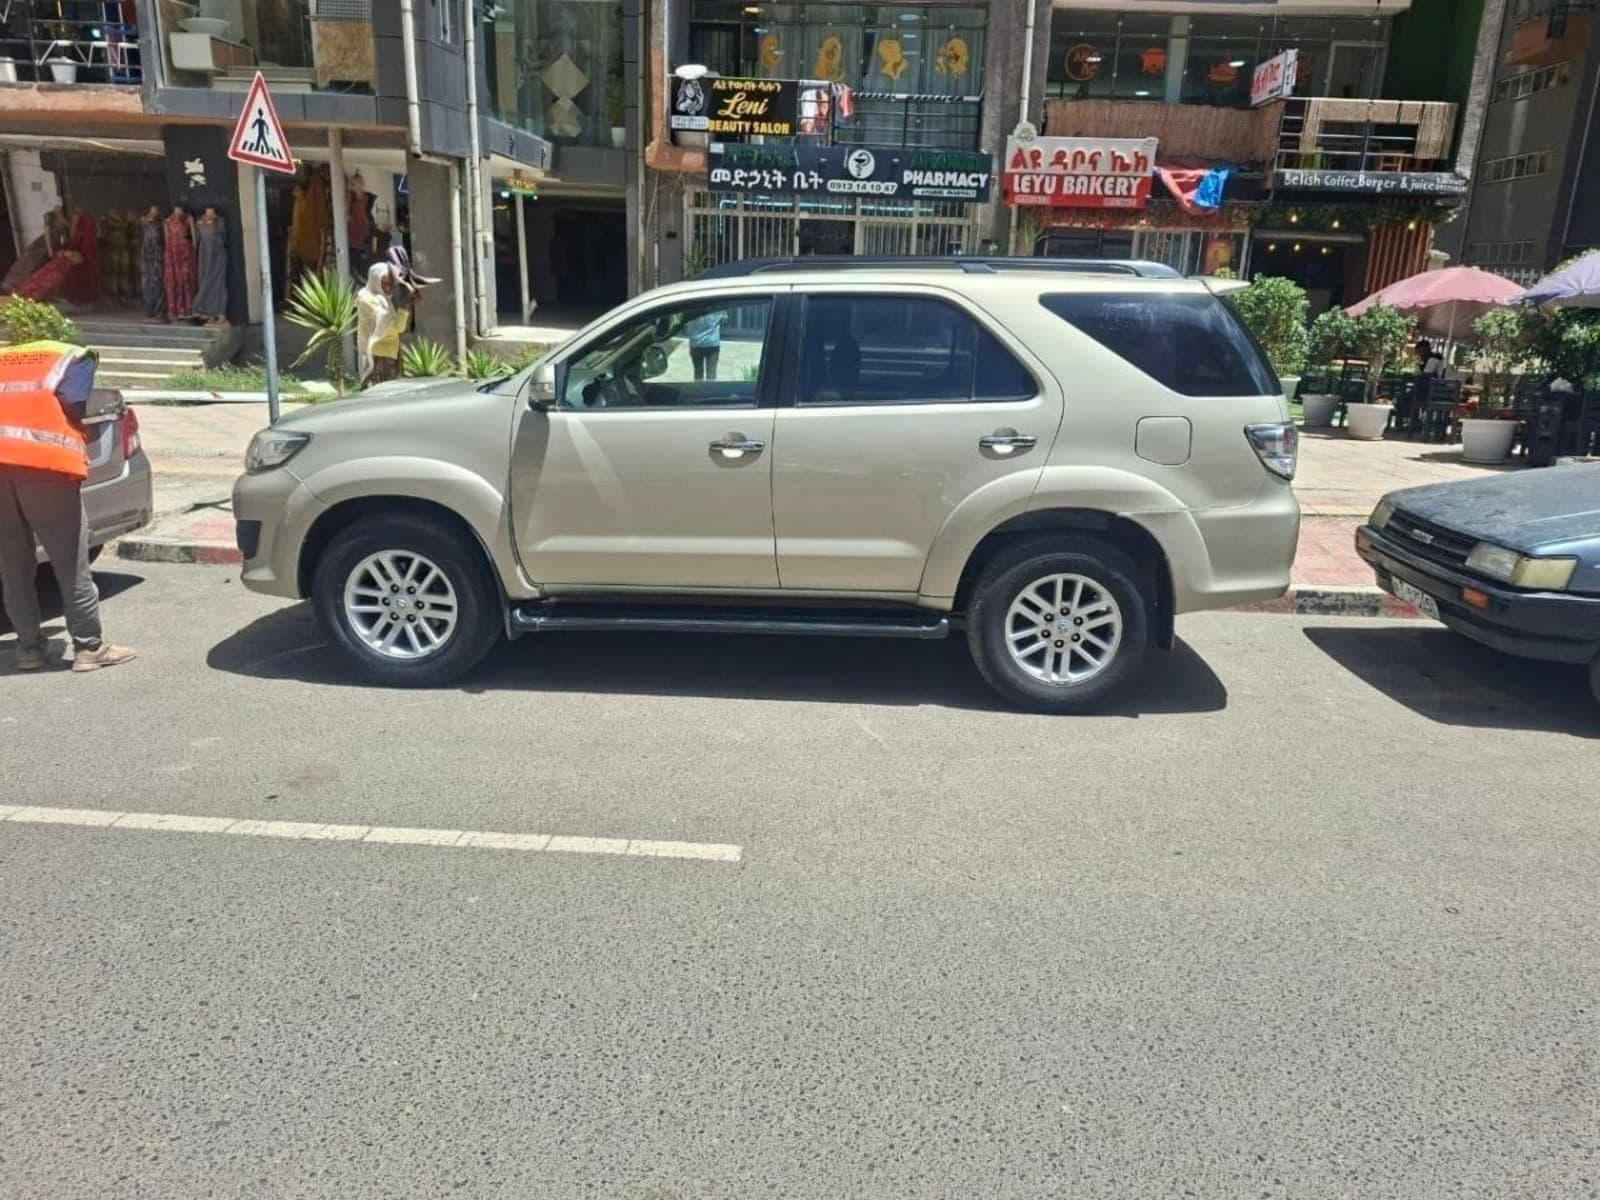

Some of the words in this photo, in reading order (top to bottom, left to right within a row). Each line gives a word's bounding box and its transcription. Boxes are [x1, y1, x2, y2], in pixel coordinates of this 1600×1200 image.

[717, 92, 769, 119] Leni
[709, 120, 752, 133] BEAUTY
[752, 121, 791, 135] SALON
[1049, 149, 1103, 171] ዳቦና
[1110, 149, 1149, 173] ኬክ
[793, 170, 824, 190] ቤት
[903, 169, 989, 188] PHARMACY
[1013, 174, 1057, 195] LEYU
[1062, 175, 1142, 196] BAKERY
[1400, 175, 1408, 189] &
[1407, 178, 1434, 192] juice
